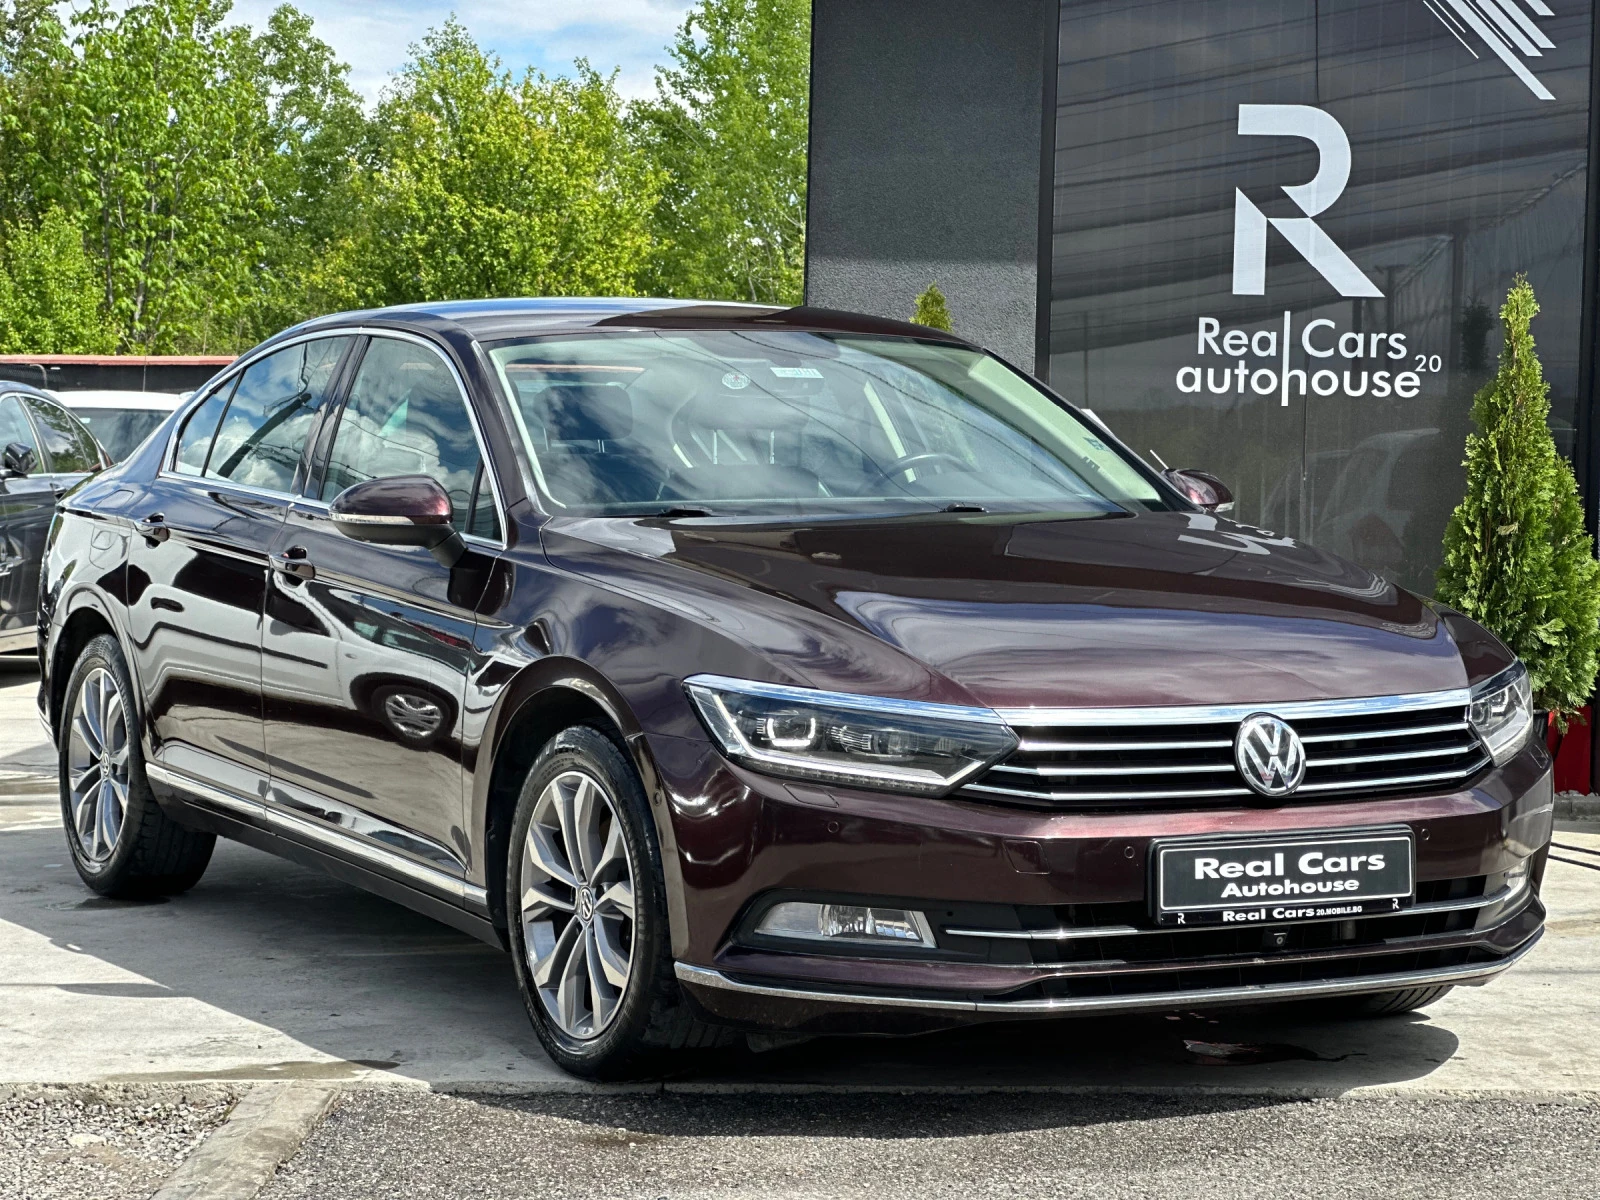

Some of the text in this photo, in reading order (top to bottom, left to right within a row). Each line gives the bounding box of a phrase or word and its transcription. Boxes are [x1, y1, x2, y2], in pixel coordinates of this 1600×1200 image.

[1232, 104, 1385, 298] R
[1197, 311, 1408, 360] Real Cars
[1175, 354, 1442, 406] autohouse 20
[1194, 851, 1386, 880] Real Cars
[1220, 878, 1360, 898] Autohouse
[1222, 905, 1363, 923] Real Cars 20.MOBILE.BG
